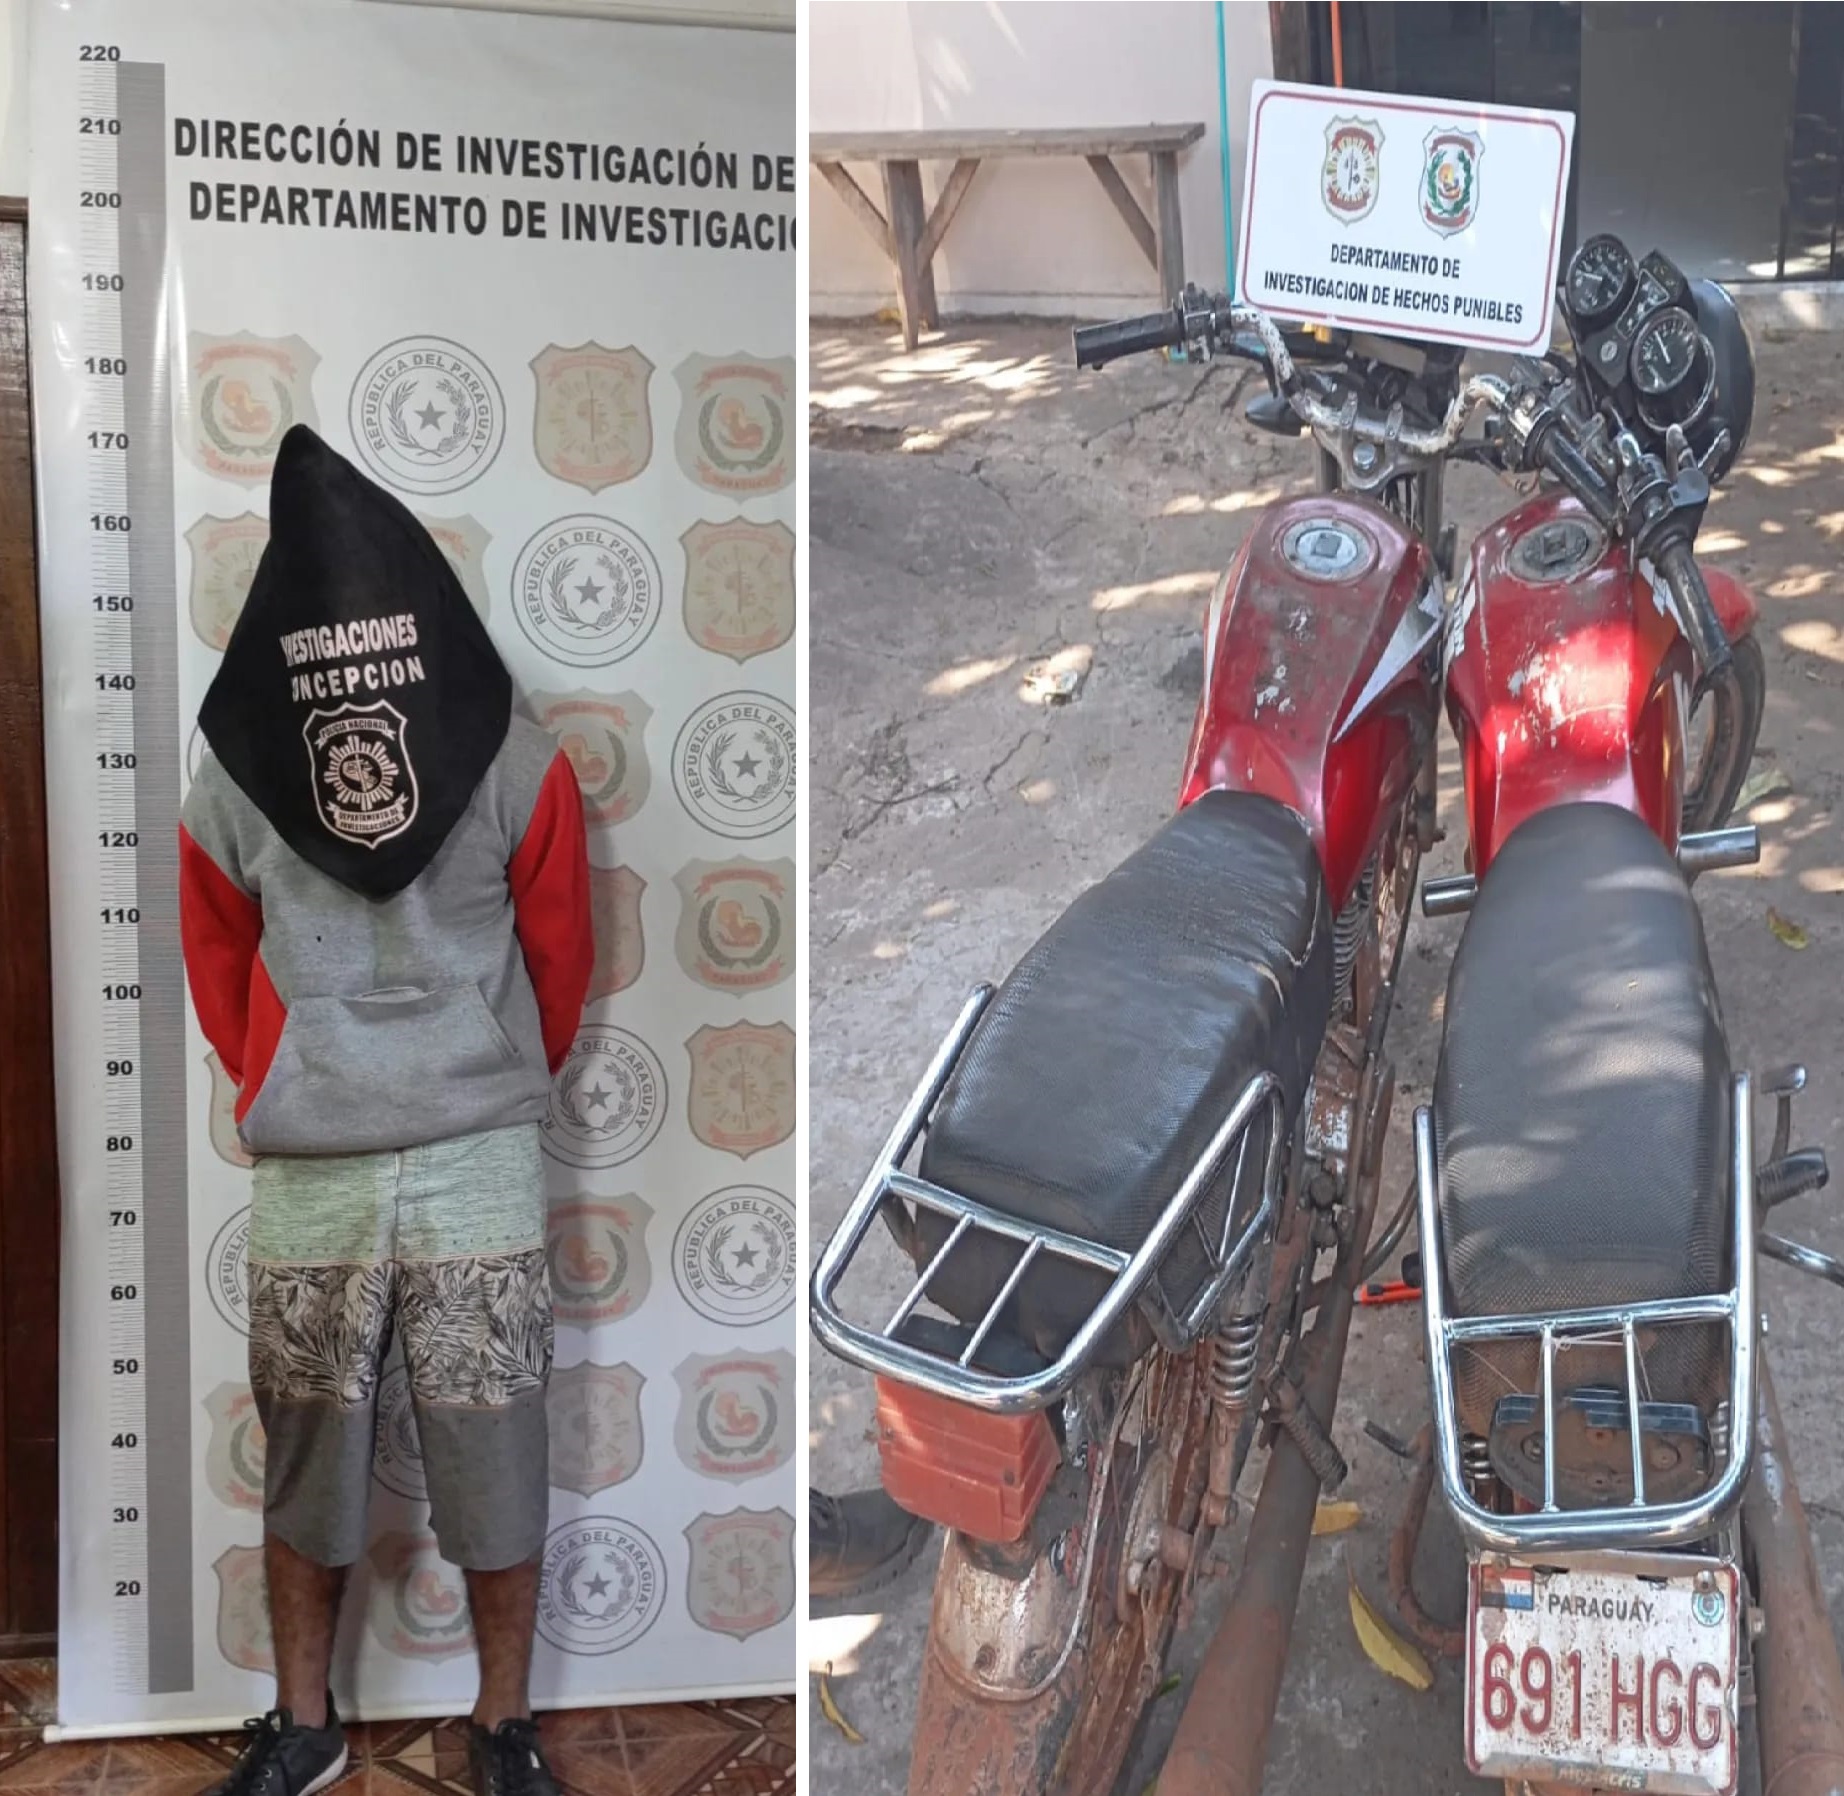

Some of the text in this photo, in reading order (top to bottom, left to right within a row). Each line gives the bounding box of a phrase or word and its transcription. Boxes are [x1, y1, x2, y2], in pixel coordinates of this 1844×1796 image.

[79, 45, 121, 61] 220
[79, 118, 121, 135] 210
[174, 117, 796, 192] DIRECCIÓN DE INVESTIGACIÓN DE
[80, 192, 122, 208] 200
[190, 181, 796, 252] DEPARTAMENTO DE INVESTIGACI
[1330, 243, 1461, 279] DEPARTAMENTO DE
[82, 274, 124, 292] 190
[1264, 270, 1523, 324] INVESTIGACION DE HECHOS PUNIBLES
[84, 358, 127, 375] 180
[366, 353, 489, 454] REPUBLICA DEL PARAGUAY
[88, 432, 129, 449] 170
[90, 515, 132, 532] 160
[526, 531, 647, 628] REPUBLICA DEL PARAGUAY
[93, 596, 134, 612] 150
[95, 675, 136, 691] 140
[97, 753, 137, 769] 130
[686, 713, 727, 799] REPUBLICA
[732, 707, 762, 720] DEL
[99, 832, 139, 848] 120
[100, 908, 140, 924] 110
[102, 984, 142, 1000] 100
[106, 1060, 133, 1075] 90
[582, 1040, 653, 1129] DEL PARAGUAY
[106, 1136, 133, 1151] 80
[110, 1211, 136, 1226] 70
[687, 1207, 727, 1290] REPUBLICA
[730, 1200, 760, 1212] DEL
[110, 1285, 137, 1301] 60
[112, 1359, 138, 1375] 50
[111, 1433, 137, 1448] 40
[113, 1507, 139, 1523] 30
[582, 1531, 612, 1543] DEL
[616, 1537, 653, 1615] PARAGUAY
[115, 1581, 141, 1596] 20
[1549, 1592, 1655, 1623] PARAGUAY
[1481, 1641, 1723, 1752] 691 HGG
